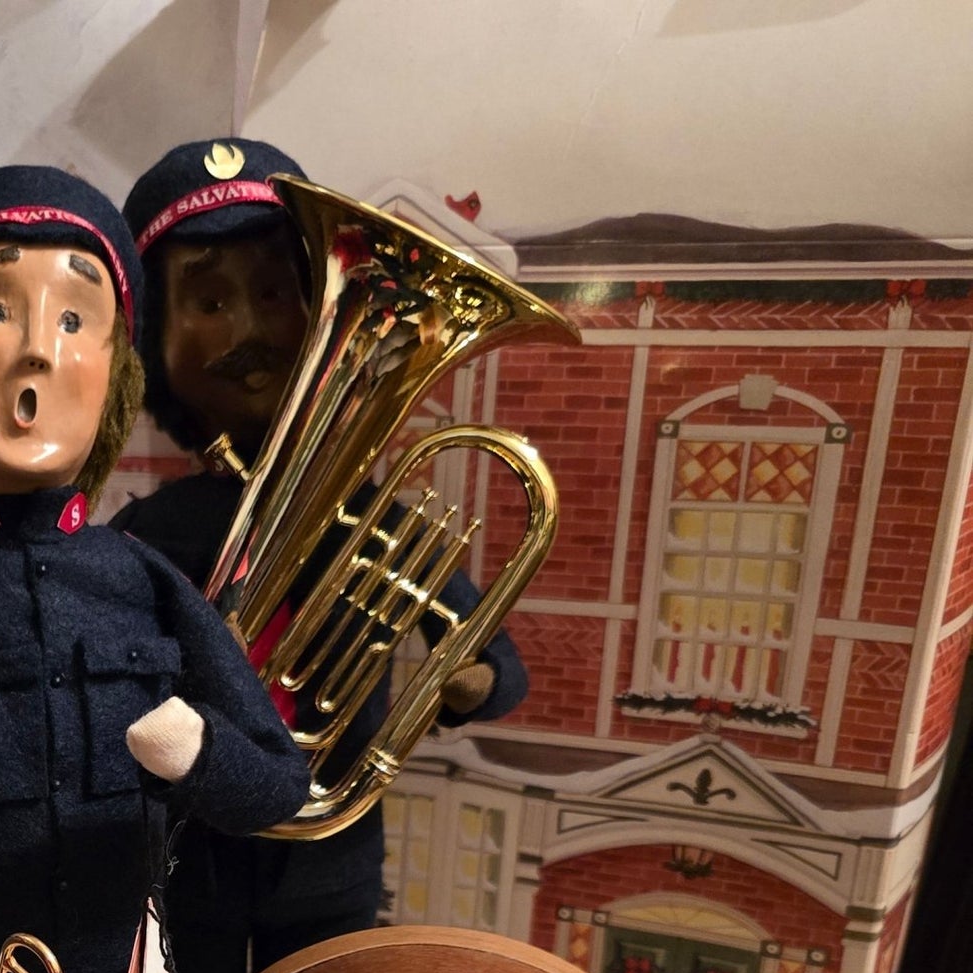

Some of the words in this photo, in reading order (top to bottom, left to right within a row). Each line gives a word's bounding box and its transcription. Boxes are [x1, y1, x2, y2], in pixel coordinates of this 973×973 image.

[141, 211, 173, 243] THE
[176, 184, 273, 214] SALVATIO
[71, 504, 81, 529] S
